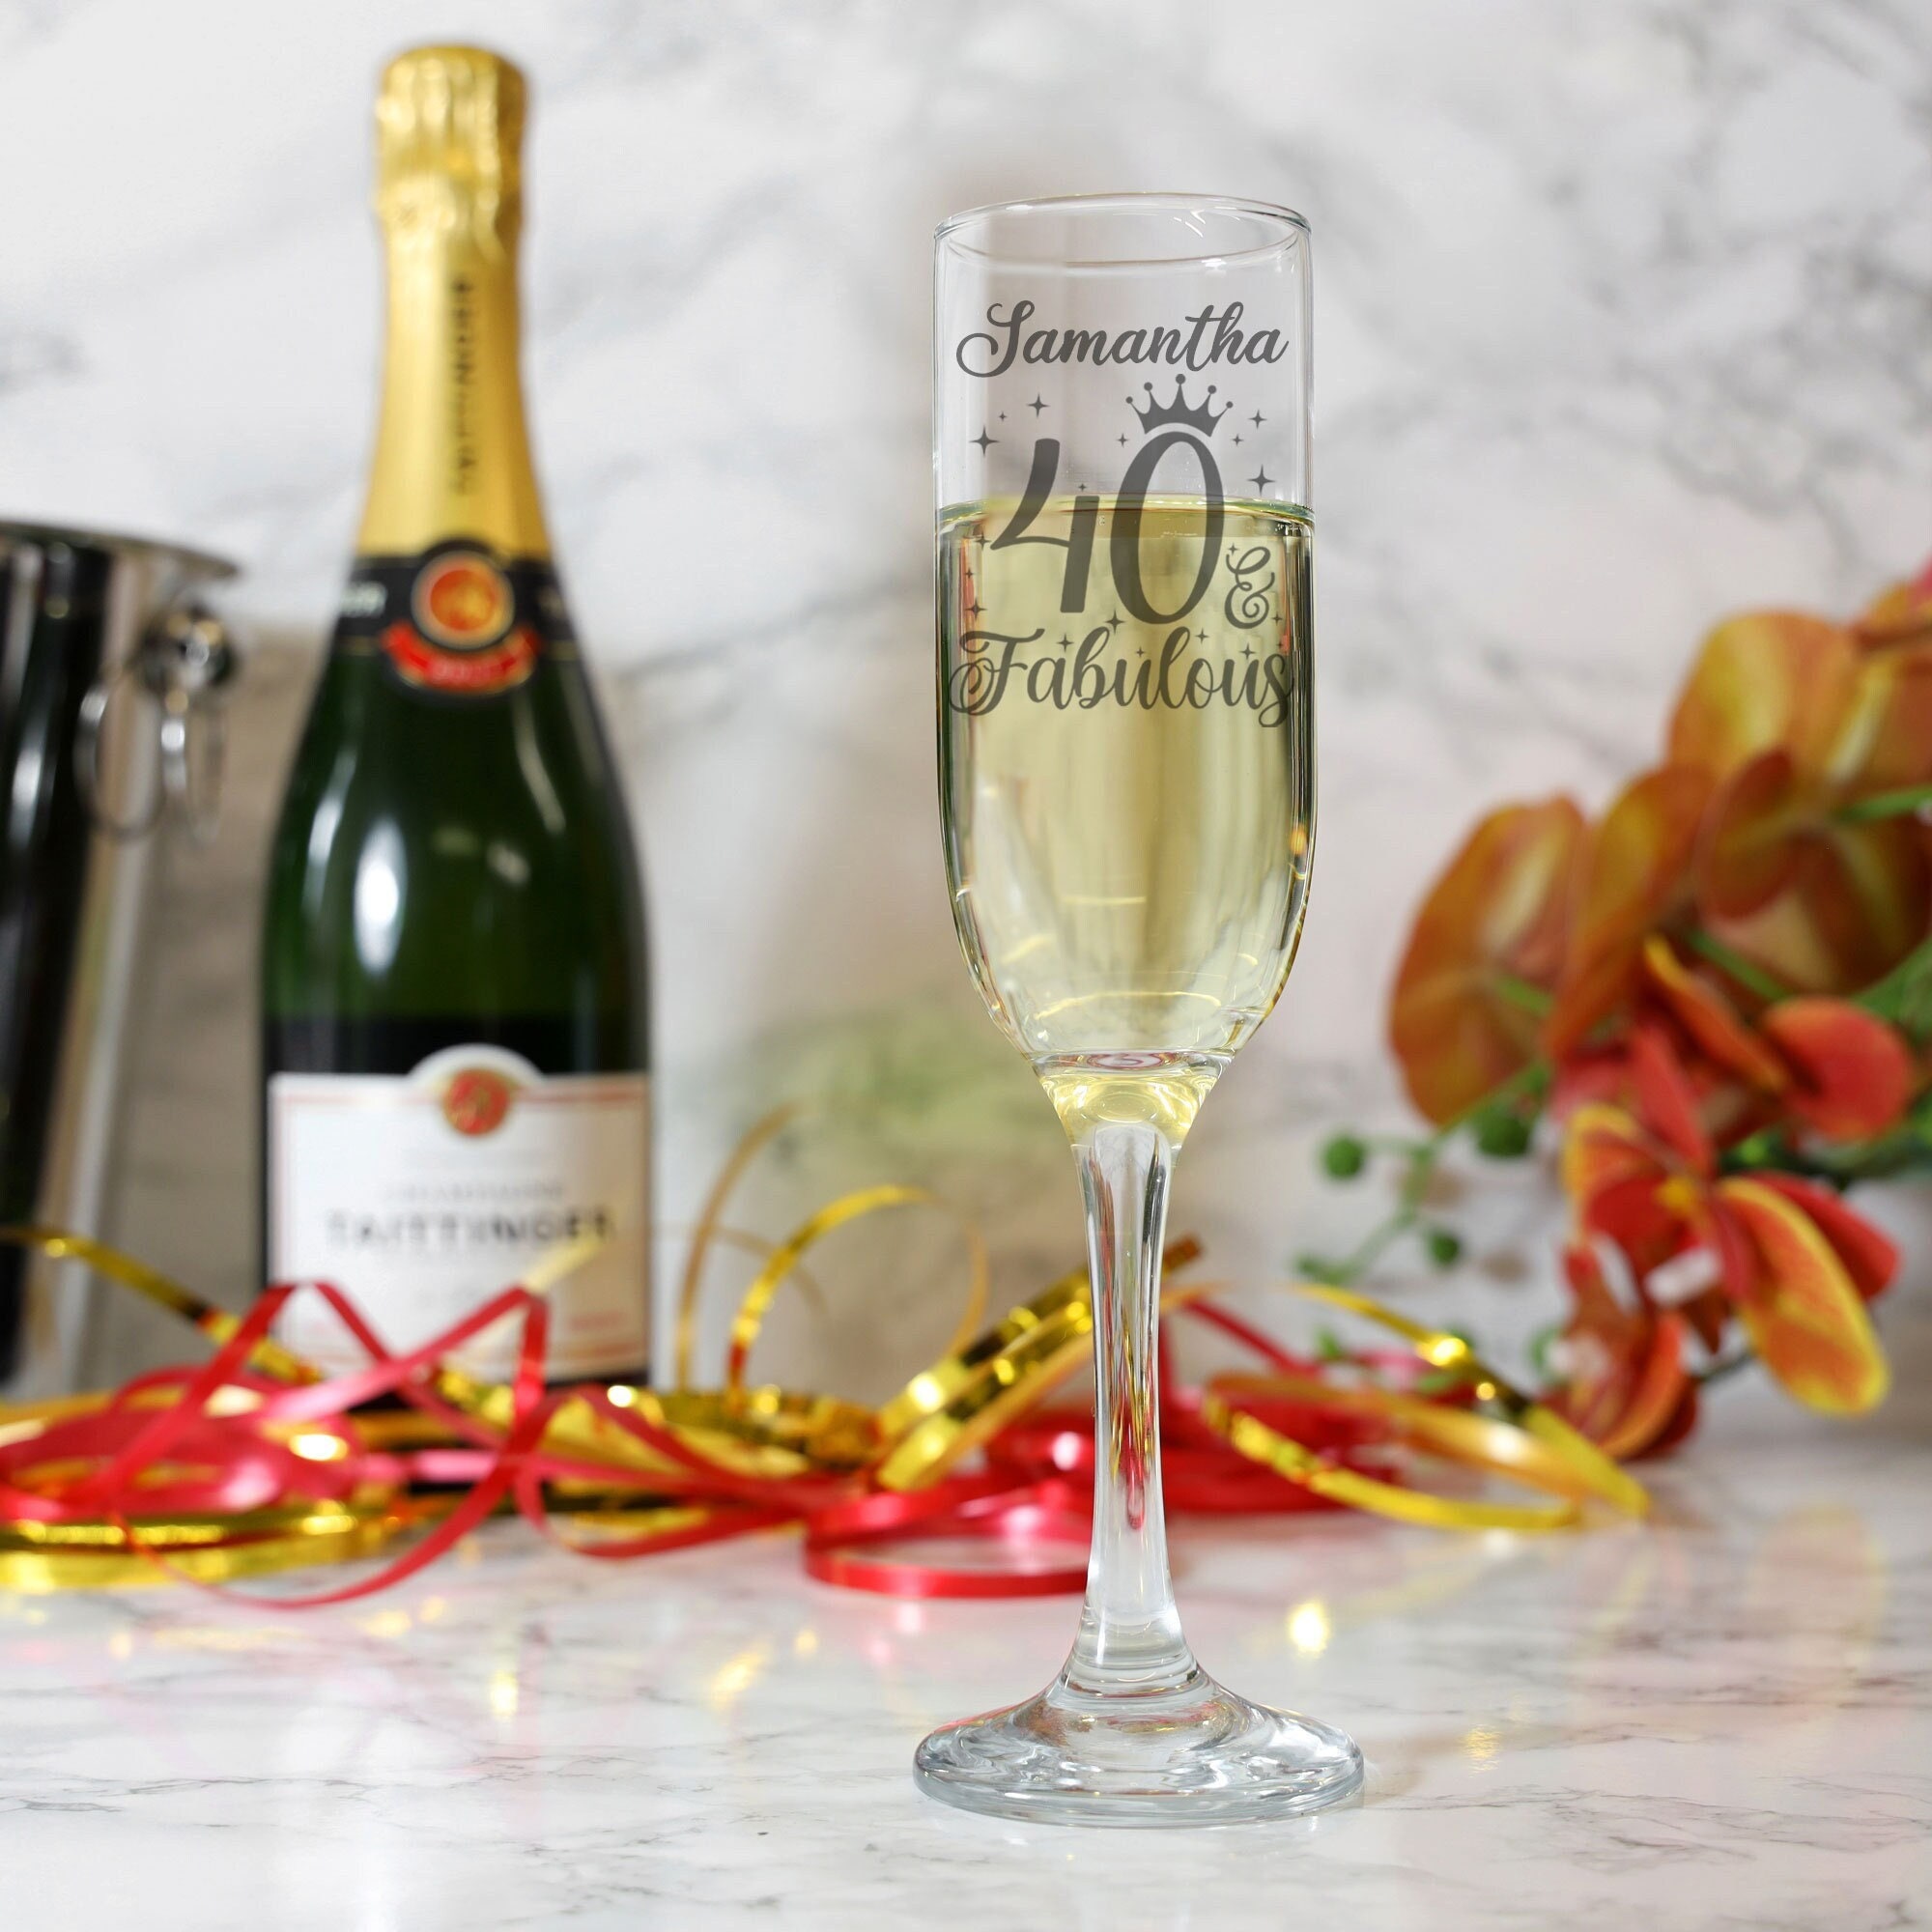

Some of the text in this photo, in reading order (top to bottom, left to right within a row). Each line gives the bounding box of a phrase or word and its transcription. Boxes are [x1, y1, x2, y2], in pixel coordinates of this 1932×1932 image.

[956, 300, 1290, 378] Samantha
[990, 431, 1275, 629] 40 &
[948, 625, 1294, 728] Fabulous
